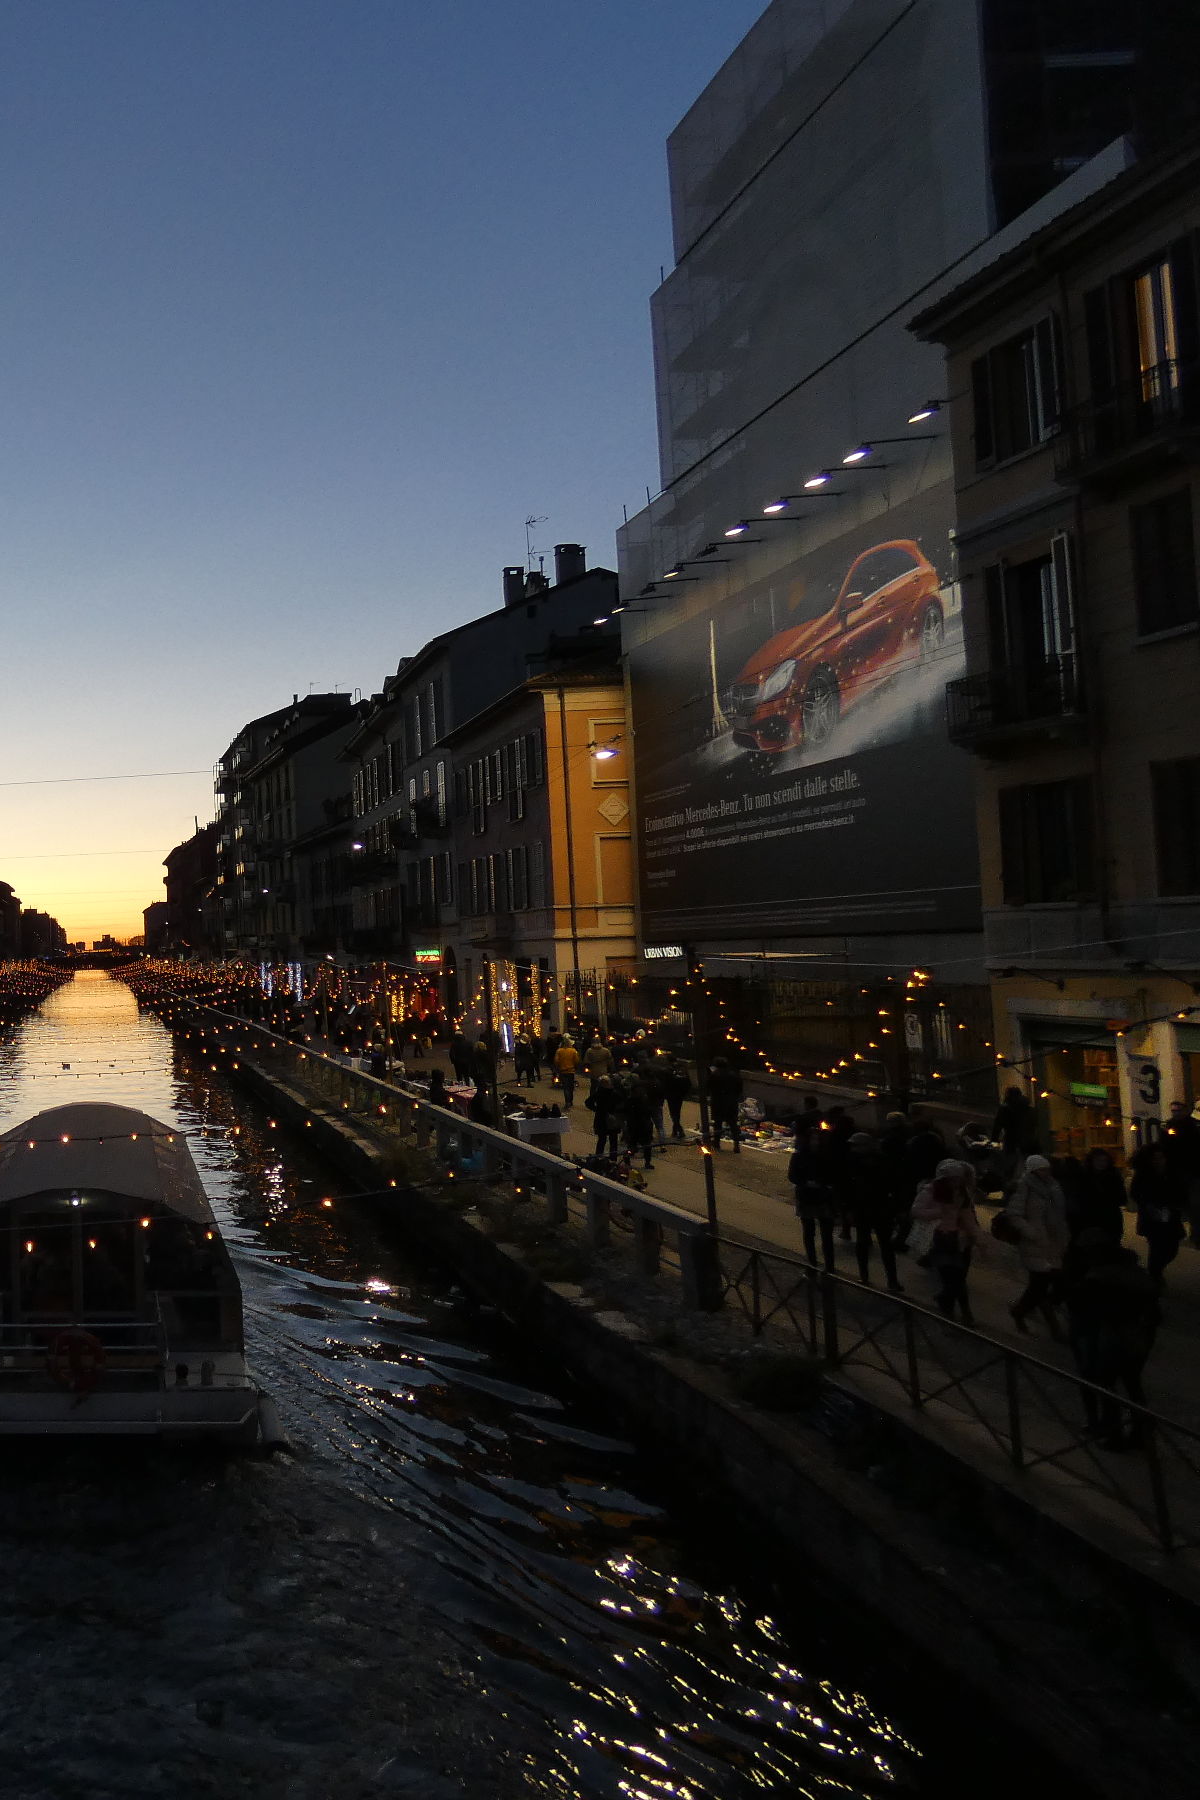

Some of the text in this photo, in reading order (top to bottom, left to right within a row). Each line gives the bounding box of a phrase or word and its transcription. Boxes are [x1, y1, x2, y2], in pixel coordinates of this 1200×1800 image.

[684, 799, 741, 825] Mercedes-Benz.
[755, 793, 771, 809] non
[773, 780, 801, 805] scendi
[803, 776, 827, 798] dalle
[829, 769, 861, 793] stelle.
[644, 946, 683, 959] URBAN VISION
